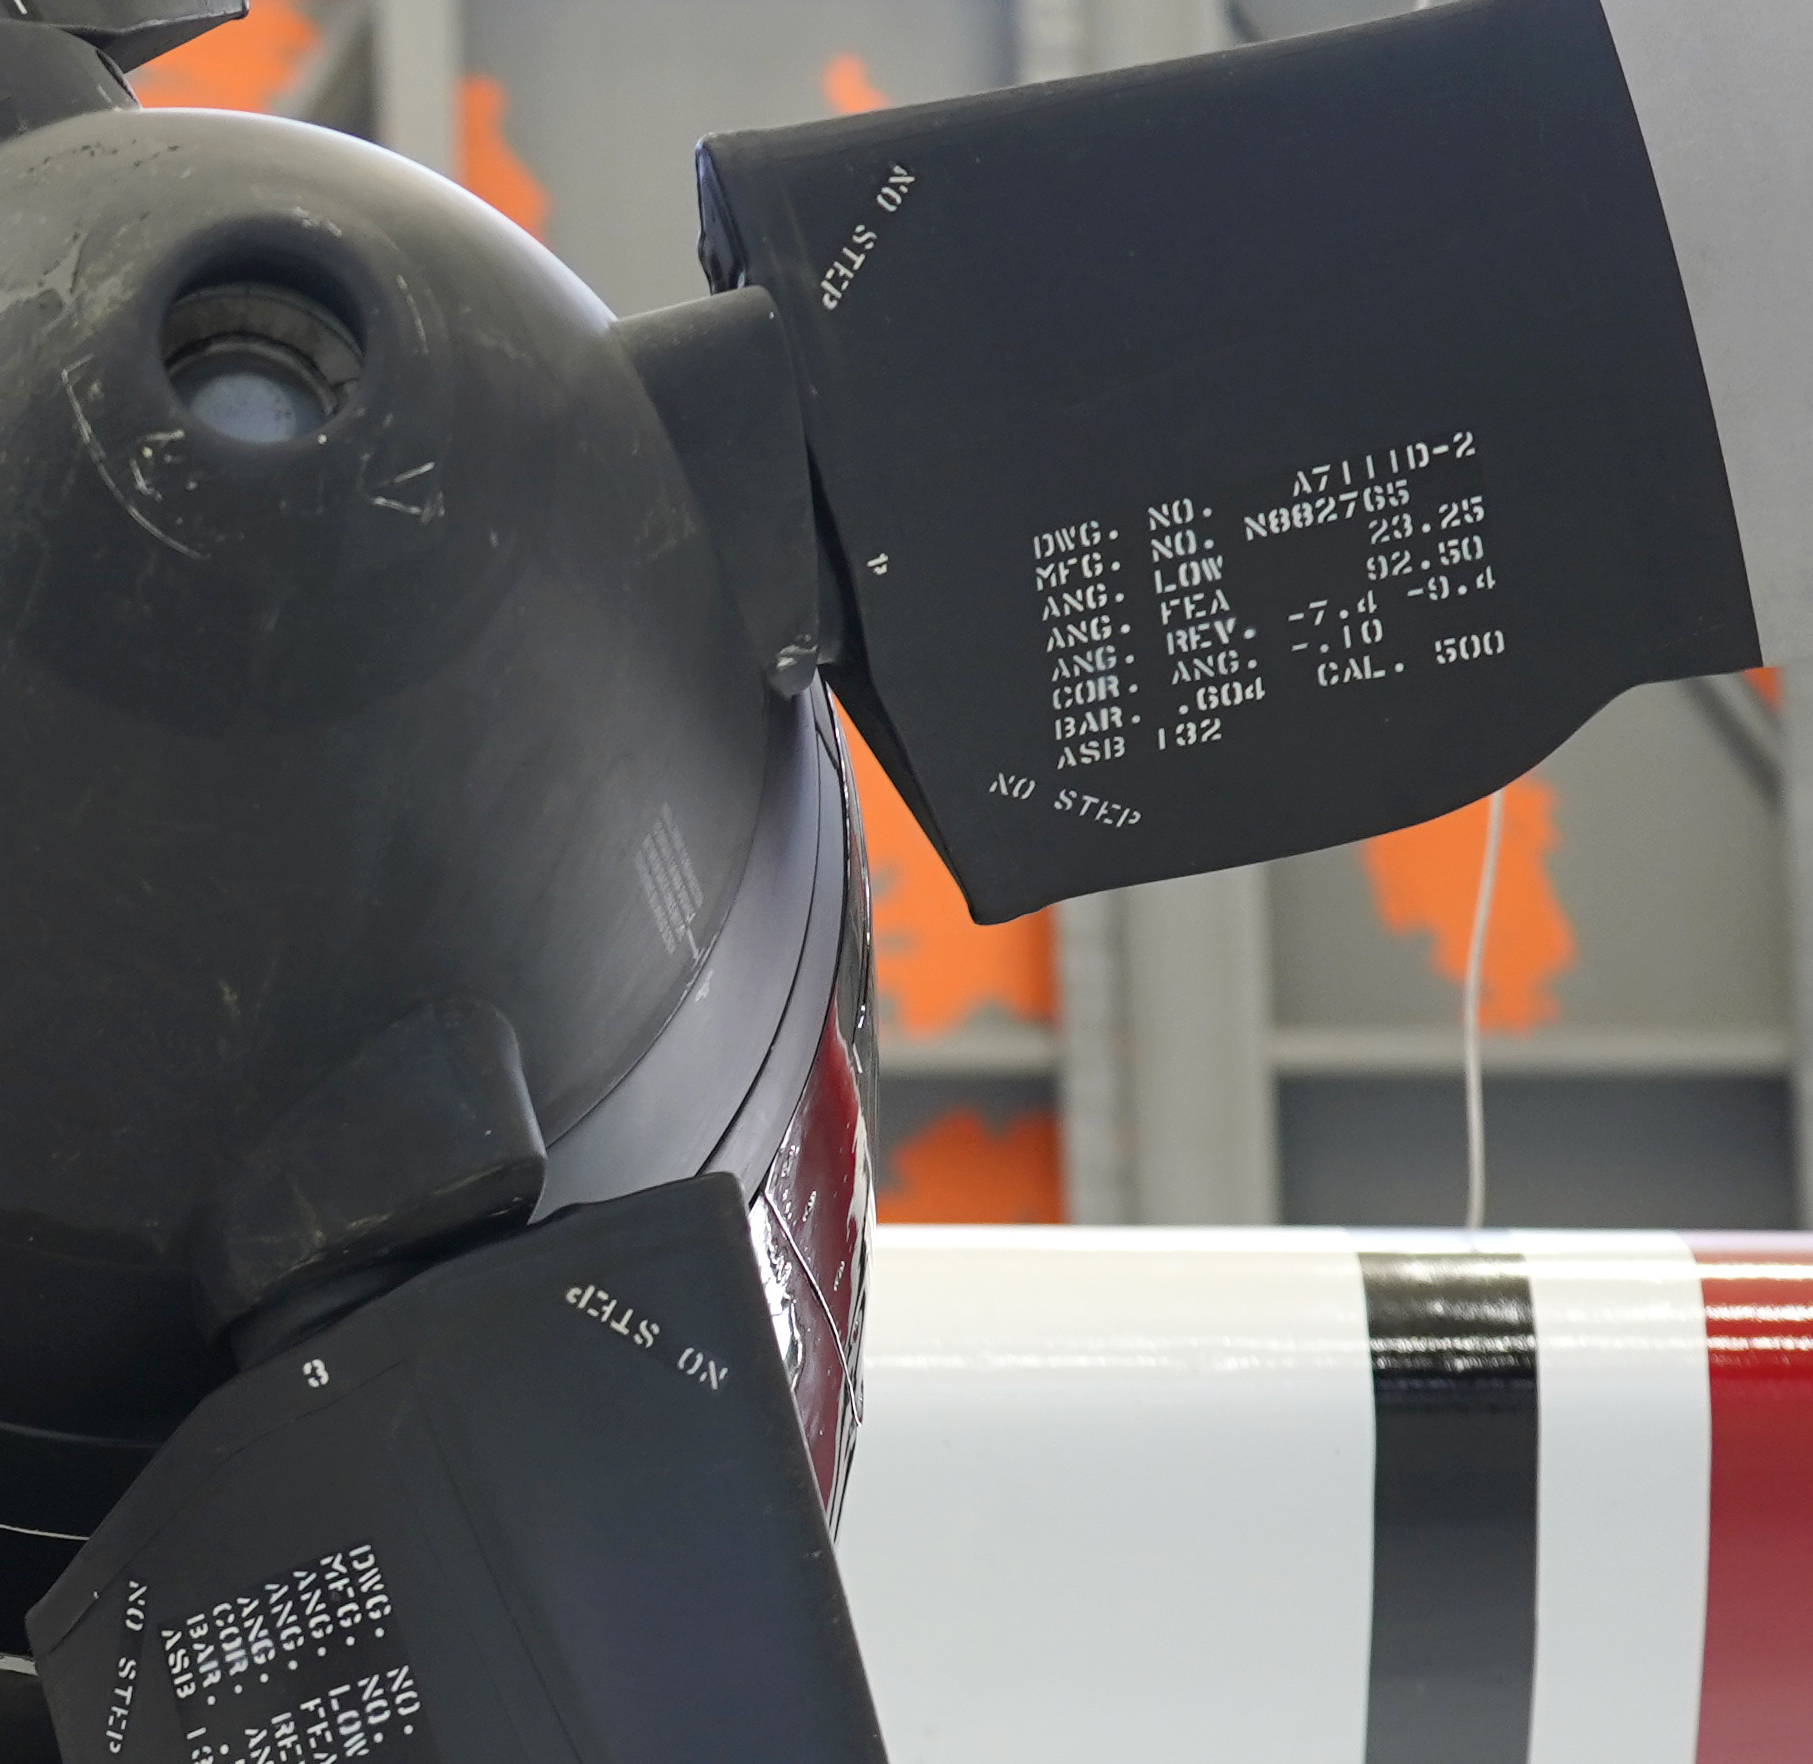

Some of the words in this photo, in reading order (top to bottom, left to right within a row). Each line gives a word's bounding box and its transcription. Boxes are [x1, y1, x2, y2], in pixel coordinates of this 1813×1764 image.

[876, 164, 916, 213] NO
[820, 224, 878, 311] STEP
[1033, 520, 1119, 560] DWG.
[1147, 497, 1213, 531] NO.
[1292, 431, 1476, 497] A7111D-2
[1035, 551, 1121, 592] MFG.
[1150, 529, 1215, 563] NO.
[1243, 478, 1410, 541] N882765
[1041, 582, 1125, 622] ANG.
[1153, 554, 1224, 594] LOW
[1368, 495, 1485, 545] 23.25
[1046, 614, 1131, 653] ANG.
[1160, 588, 1231, 626] FEA
[1366, 534, 1484, 581] 92.50
[1051, 644, 1135, 682] ANG.
[1166, 617, 1257, 656] REV.
[1287, 589, 1378, 626] -7.4
[1406, 565, 1496, 601] -9.4
[1052, 675, 1139, 711] COR.
[1171, 649, 1258, 686] ANG.
[1054, 705, 1141, 741] BAR.
[1178, 676, 1266, 715] .604
[1317, 655, 1405, 687] CAL.
[1434, 629, 1505, 665] 500
[1057, 735, 1126, 770] ASB
[1157, 717, 1222, 751] 132
[988, 772, 1036, 800] NO
[1053, 788, 1142, 828] STEP
[565, 1284, 660, 1349] STEP
[303, 1359, 328, 1387] 3
[677, 1347, 729, 1391] NO
[125, 1580, 148, 1632] NO
[212, 1602, 249, 1695] COR.
[236, 1597, 276, 1684] ANG.
[264, 1583, 305, 1671] ANG.
[319, 1552, 362, 1647] MFG.
[356, 1673, 392, 1744] NO.
[348, 1544, 392, 1638] DWG.
[386, 1664, 421, 1735] NO.
[161, 1630, 197, 1699] ASB
[186, 1613, 222, 1706] BAR.
[292, 1571, 334, 1657] ANG.
[327, 1683, 370, 1758] LOW
[105, 1656, 137, 1754] STEP
